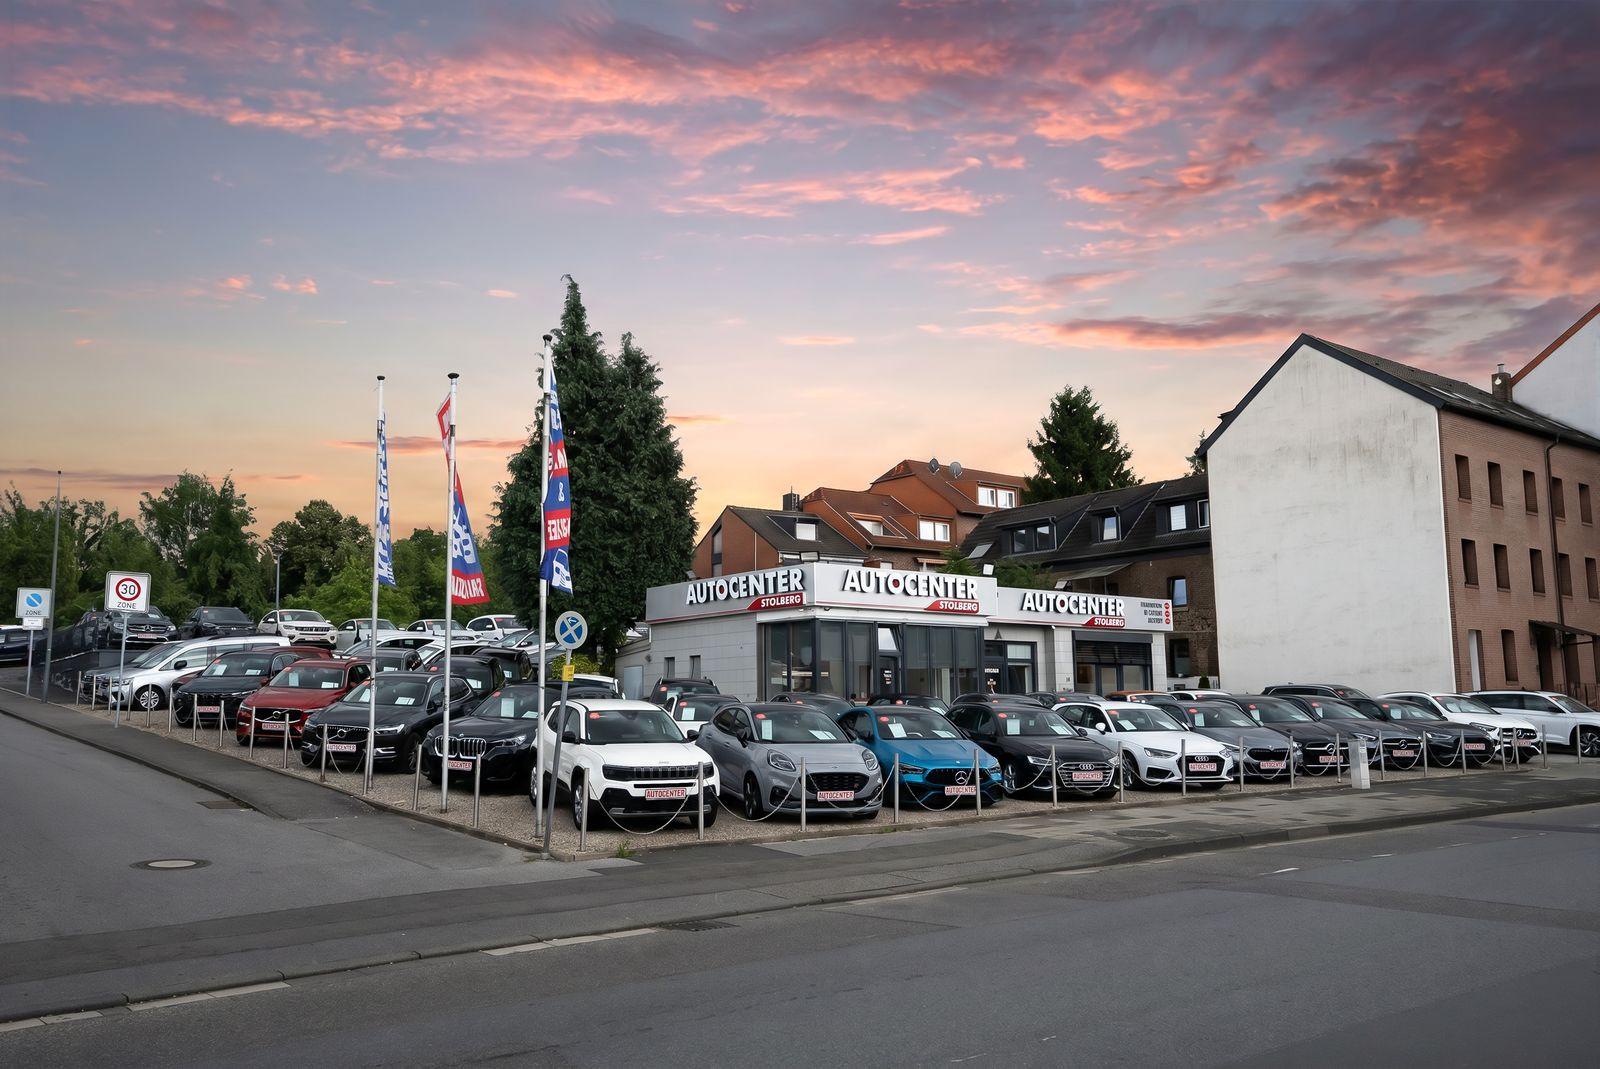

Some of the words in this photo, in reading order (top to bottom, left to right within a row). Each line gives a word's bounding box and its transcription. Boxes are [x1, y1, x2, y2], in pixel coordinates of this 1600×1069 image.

[121, 583, 136, 595] 30
[686, 568, 804, 605] AUTOCENTER
[843, 569, 978, 599] AUTOCENTER
[760, 594, 801, 607] STOLBERG
[939, 600, 978, 611] STOLBERG
[1021, 592, 1126, 616] AUTOCENTER
[1094, 617, 1125, 627] STOLBERG
[448, 761, 471, 770] TOCENTER
[646, 788, 685, 799] AUTOCENTER
[818, 791, 854, 799] AUTOCENTER
